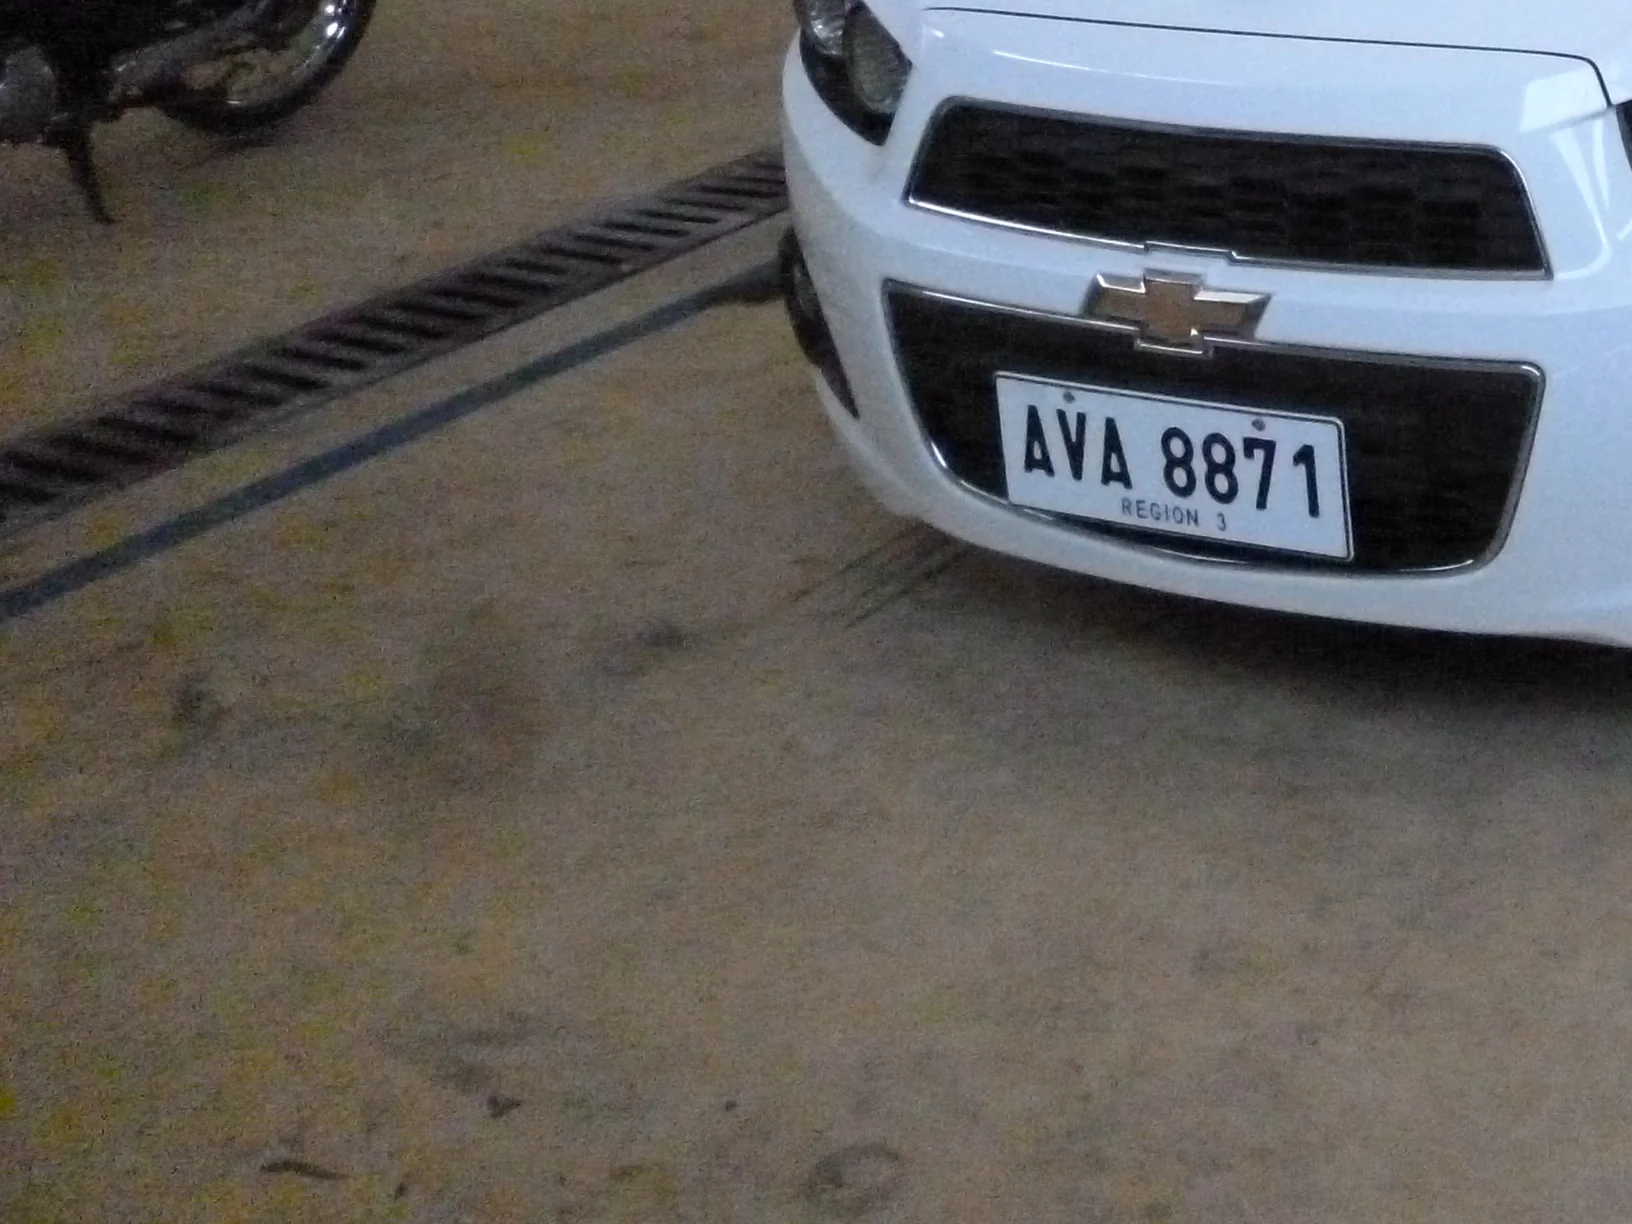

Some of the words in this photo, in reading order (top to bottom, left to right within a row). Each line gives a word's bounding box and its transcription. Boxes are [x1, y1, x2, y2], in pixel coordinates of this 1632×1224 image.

[1023, 405, 1133, 490] AVA
[1160, 426, 1320, 519] 8871
[1121, 498, 1199, 528] REGION
[1217, 512, 1227, 532] 3
